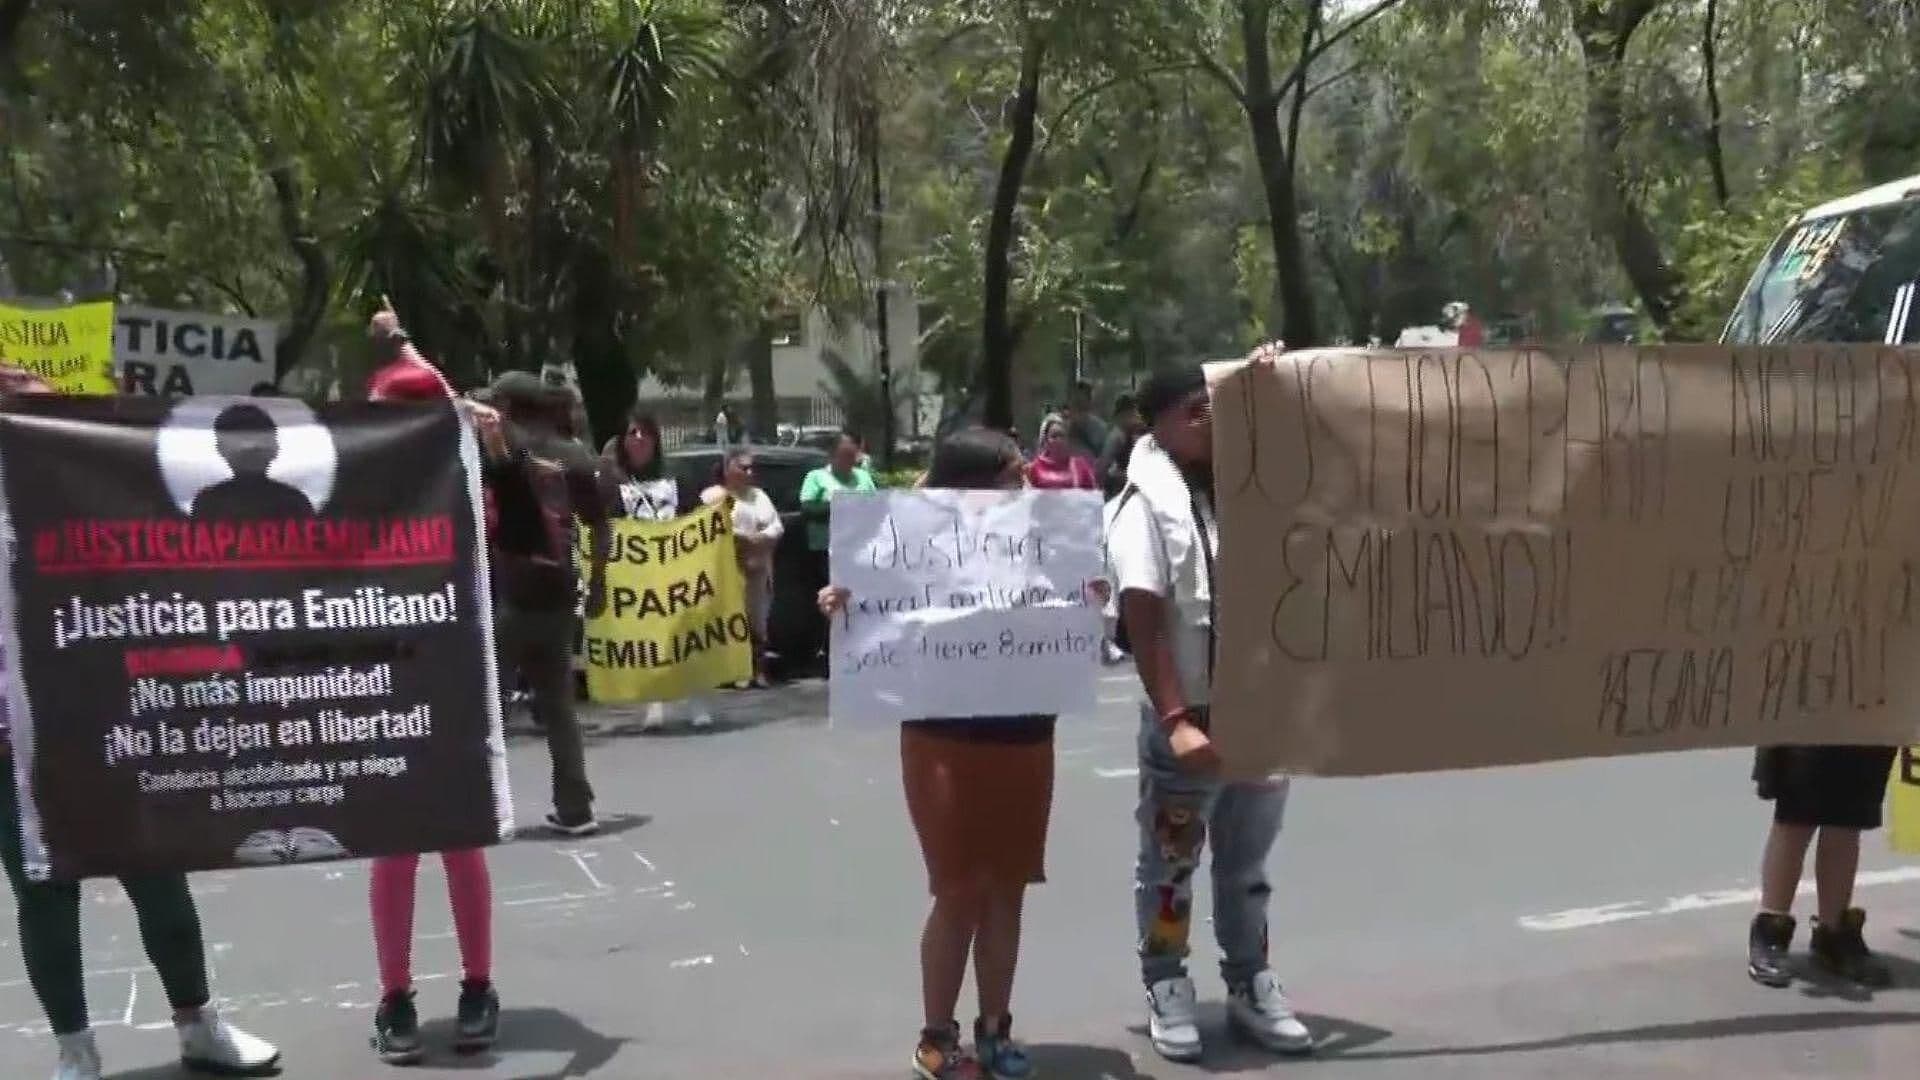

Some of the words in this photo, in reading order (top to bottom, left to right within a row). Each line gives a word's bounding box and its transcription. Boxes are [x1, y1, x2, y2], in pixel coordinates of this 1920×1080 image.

[118, 317, 263, 363] TICIA
[122, 360, 195, 396] RA
[53, 592, 209, 649] ¡Justicia
[216, 594, 297, 640] para
[302, 582, 459, 630] Emiliano!
[613, 569, 715, 619] PARA
[586, 611, 751, 669] EMILIANO
[128, 677, 176, 716] ¡No
[181, 673, 241, 709] más
[244, 663, 392, 708] impunidad!
[103, 723, 154, 766] ¡No
[158, 720, 188, 754] la
[192, 717, 272, 758] dejen
[276, 720, 313, 746] en
[317, 703, 432, 744] libertad!
